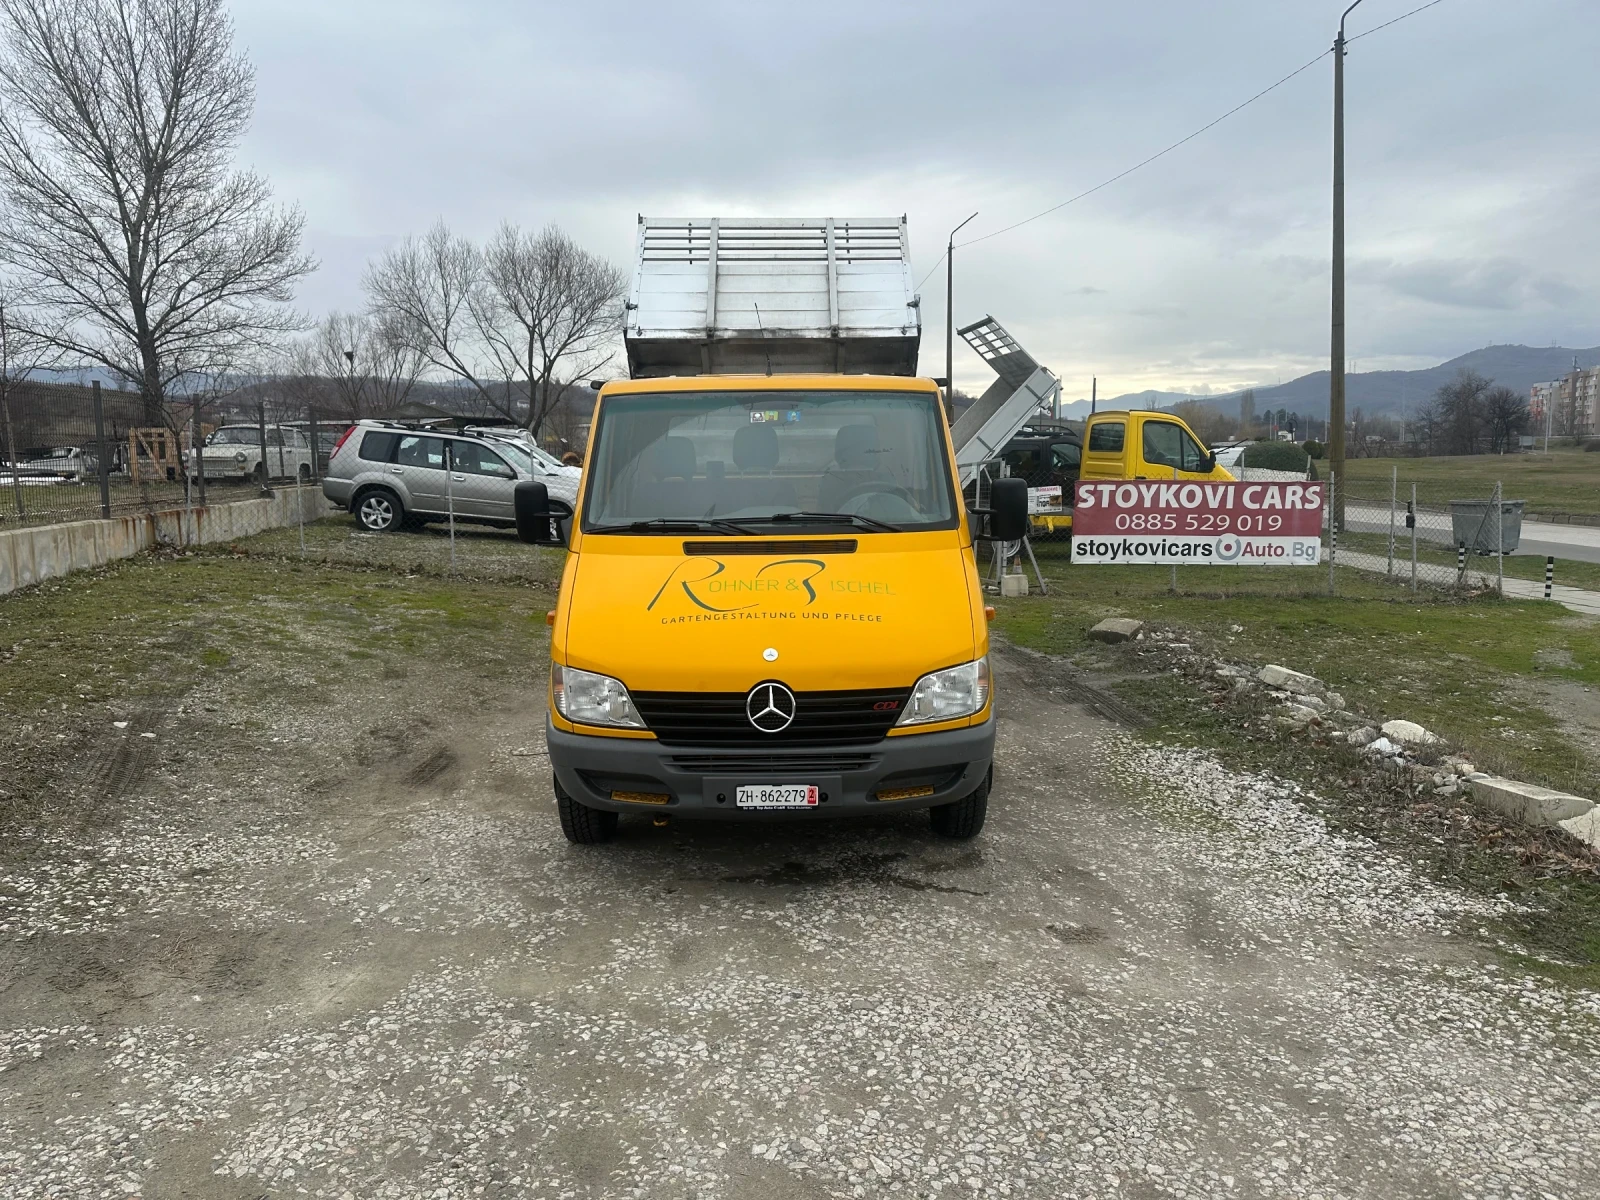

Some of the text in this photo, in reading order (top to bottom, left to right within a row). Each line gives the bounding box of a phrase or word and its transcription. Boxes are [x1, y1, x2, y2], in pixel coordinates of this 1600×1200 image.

[1077, 484, 1321, 510] STOYKOVI CARS
[1115, 513, 1282, 531] 0885 529 019
[1076, 538, 1316, 561] stoykovicars Auto.Bg
[661, 612, 882, 625] GARTENGESTALTUNG UND PFLEGE
[873, 701, 899, 710] CDI
